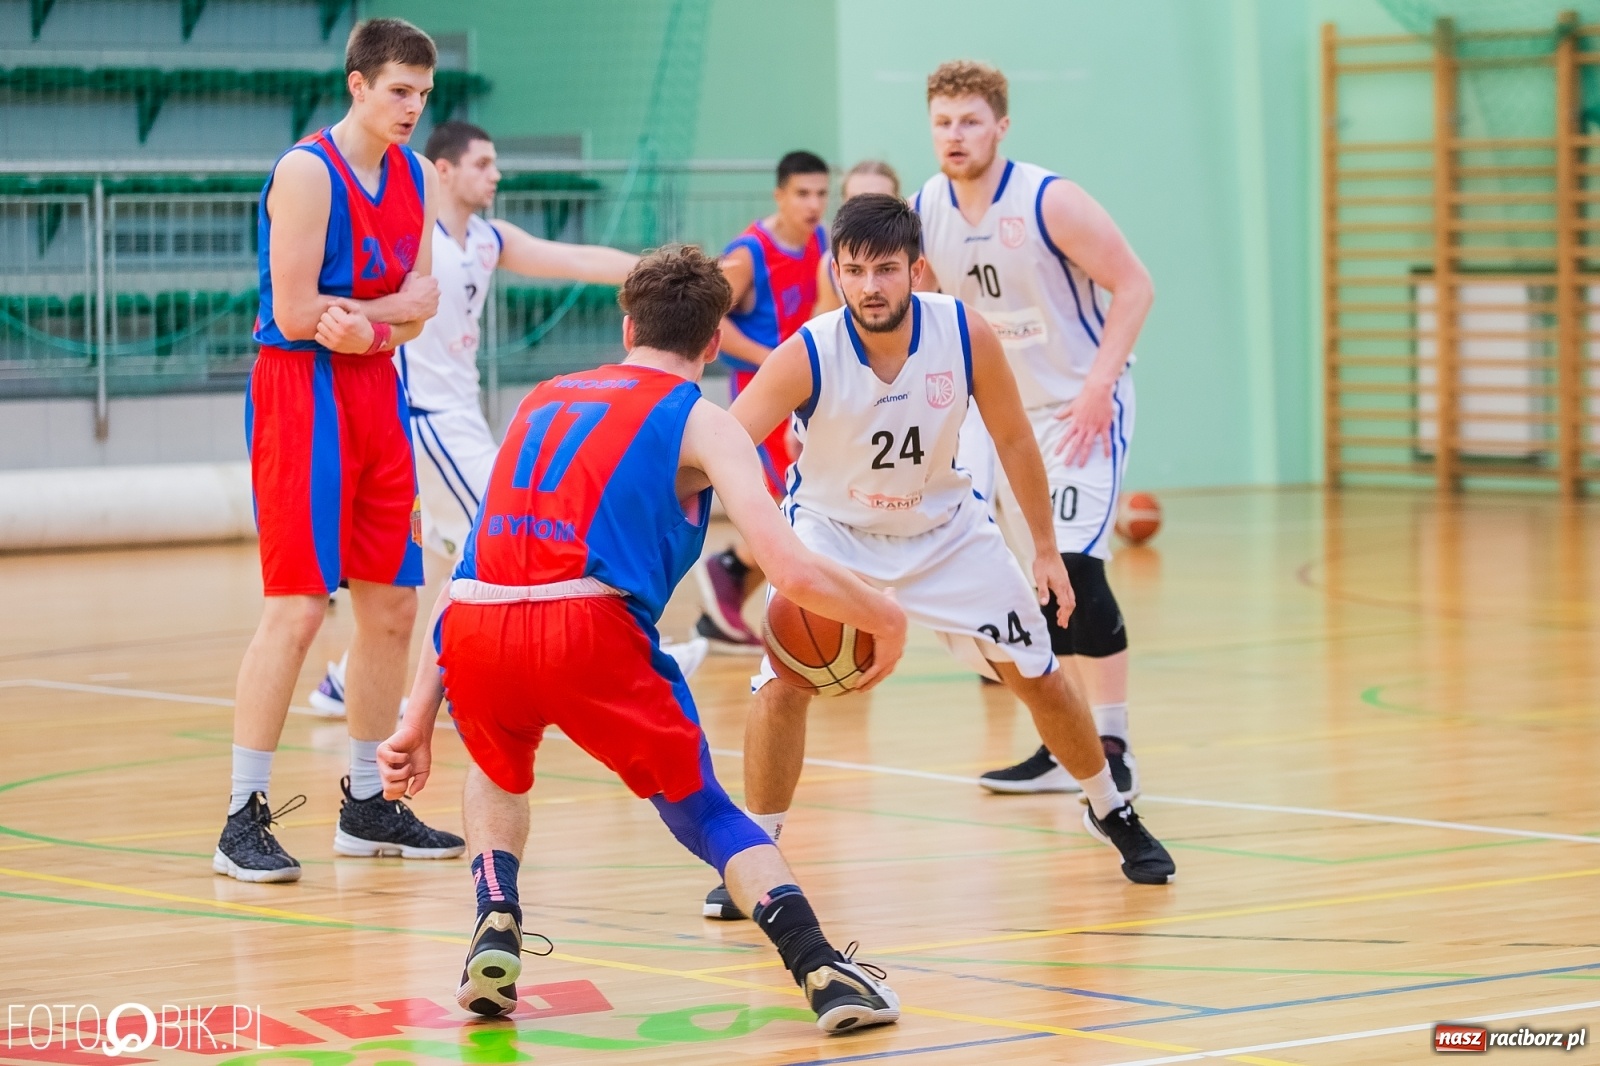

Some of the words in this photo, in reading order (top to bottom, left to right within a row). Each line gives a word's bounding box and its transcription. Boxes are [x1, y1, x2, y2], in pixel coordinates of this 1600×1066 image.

[967, 264, 1001, 298] 10
[554, 379, 639, 390] MOSM
[511, 400, 612, 493] 17
[871, 425, 925, 470] 24
[487, 514, 575, 542] BYTOM
